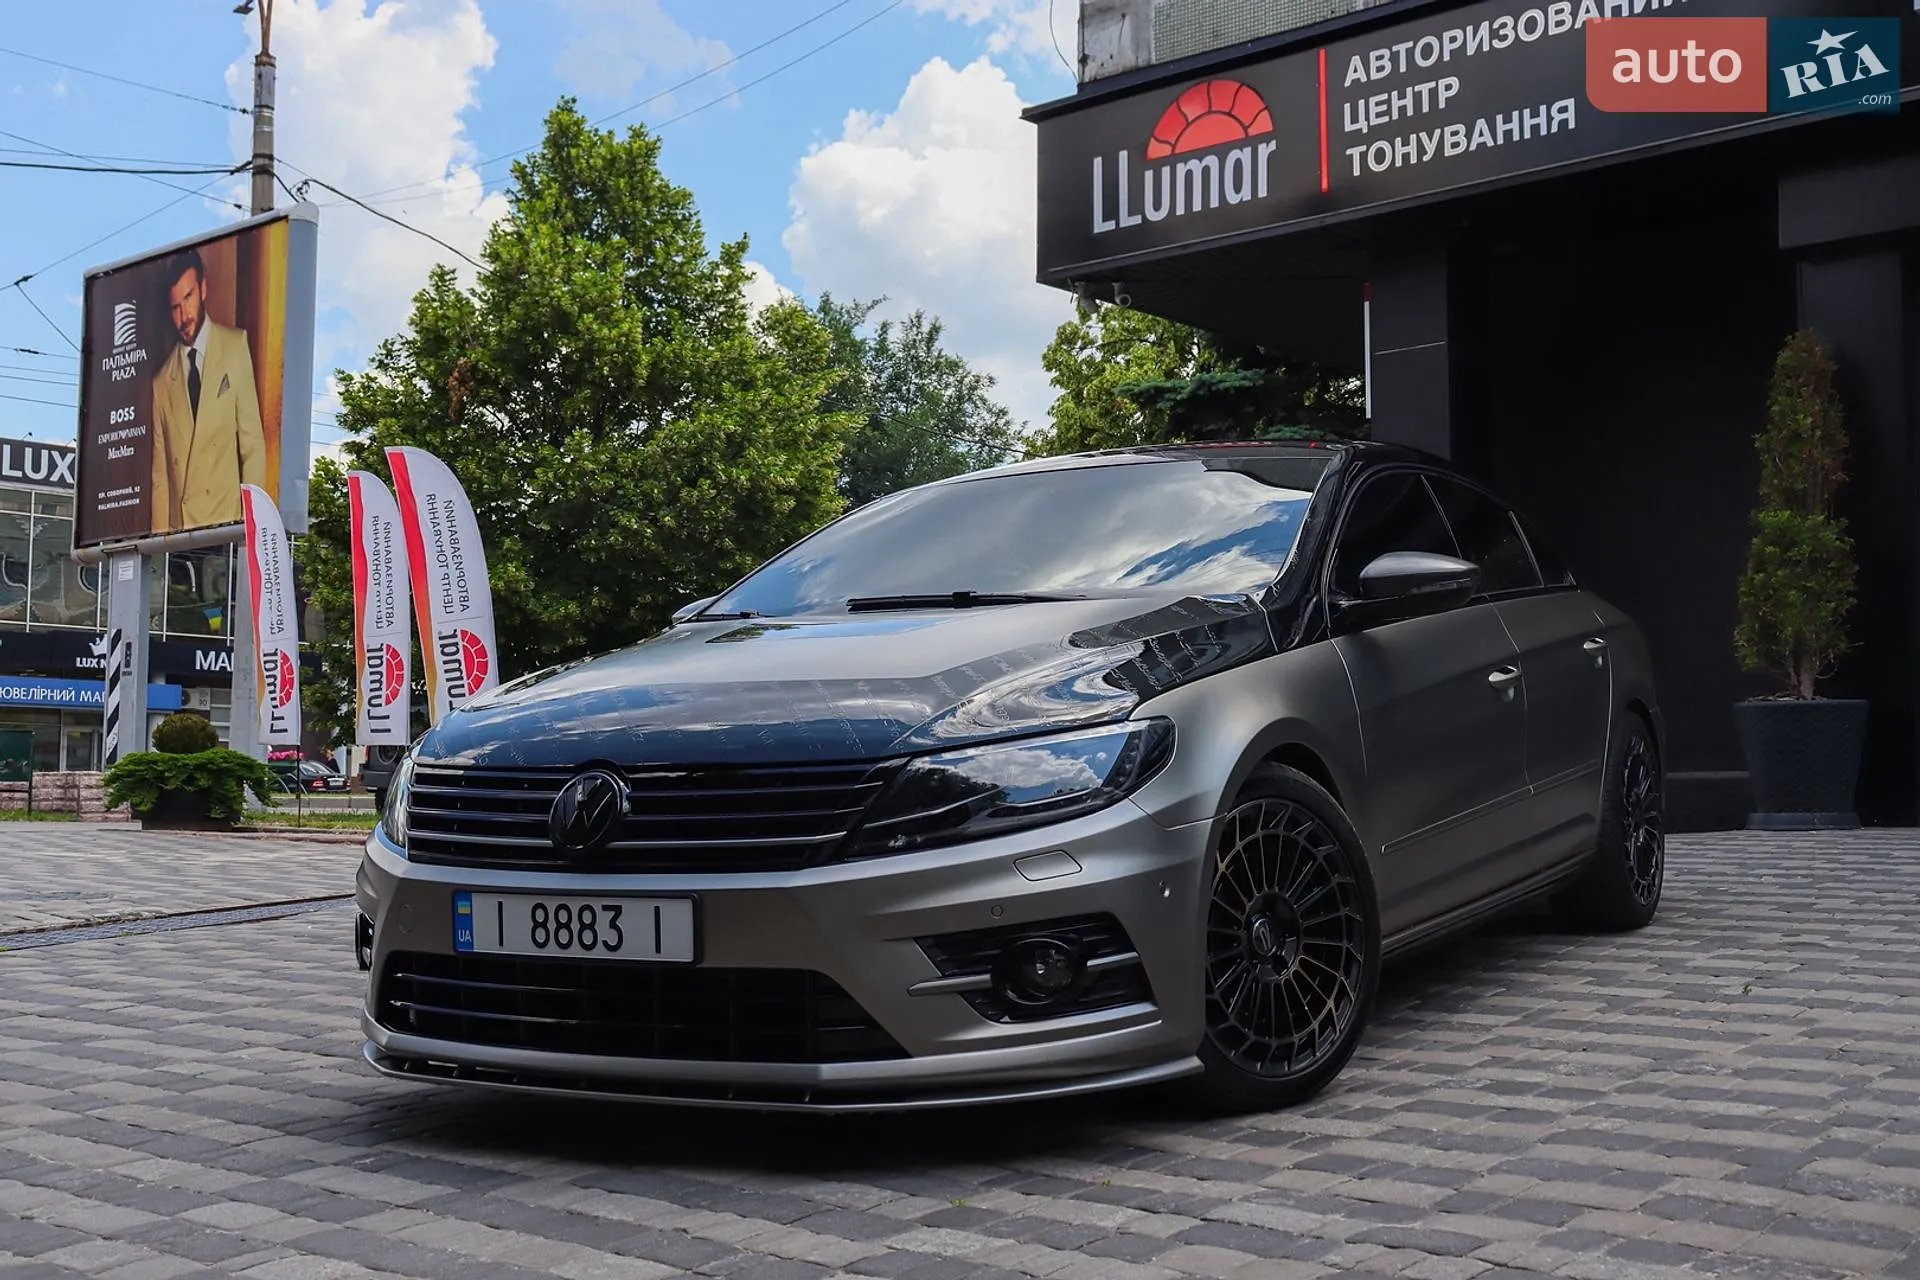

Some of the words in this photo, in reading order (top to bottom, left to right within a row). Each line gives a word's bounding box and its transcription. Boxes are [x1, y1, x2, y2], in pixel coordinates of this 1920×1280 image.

[1344, 0, 1688, 87] АВТОРИЗОВАН
[1344, 76, 1460, 134] ЦЕНТР
[1345, 98, 1576, 176] ТОНУВАННЯ
[1093, 139, 1277, 234] LLumar
[110, 406, 136, 425] BOSS
[2, 444, 76, 484] LUX
[76, 656, 98, 668] LUX
[458, 929, 472, 943] UA
[531, 902, 624, 952] 8883
